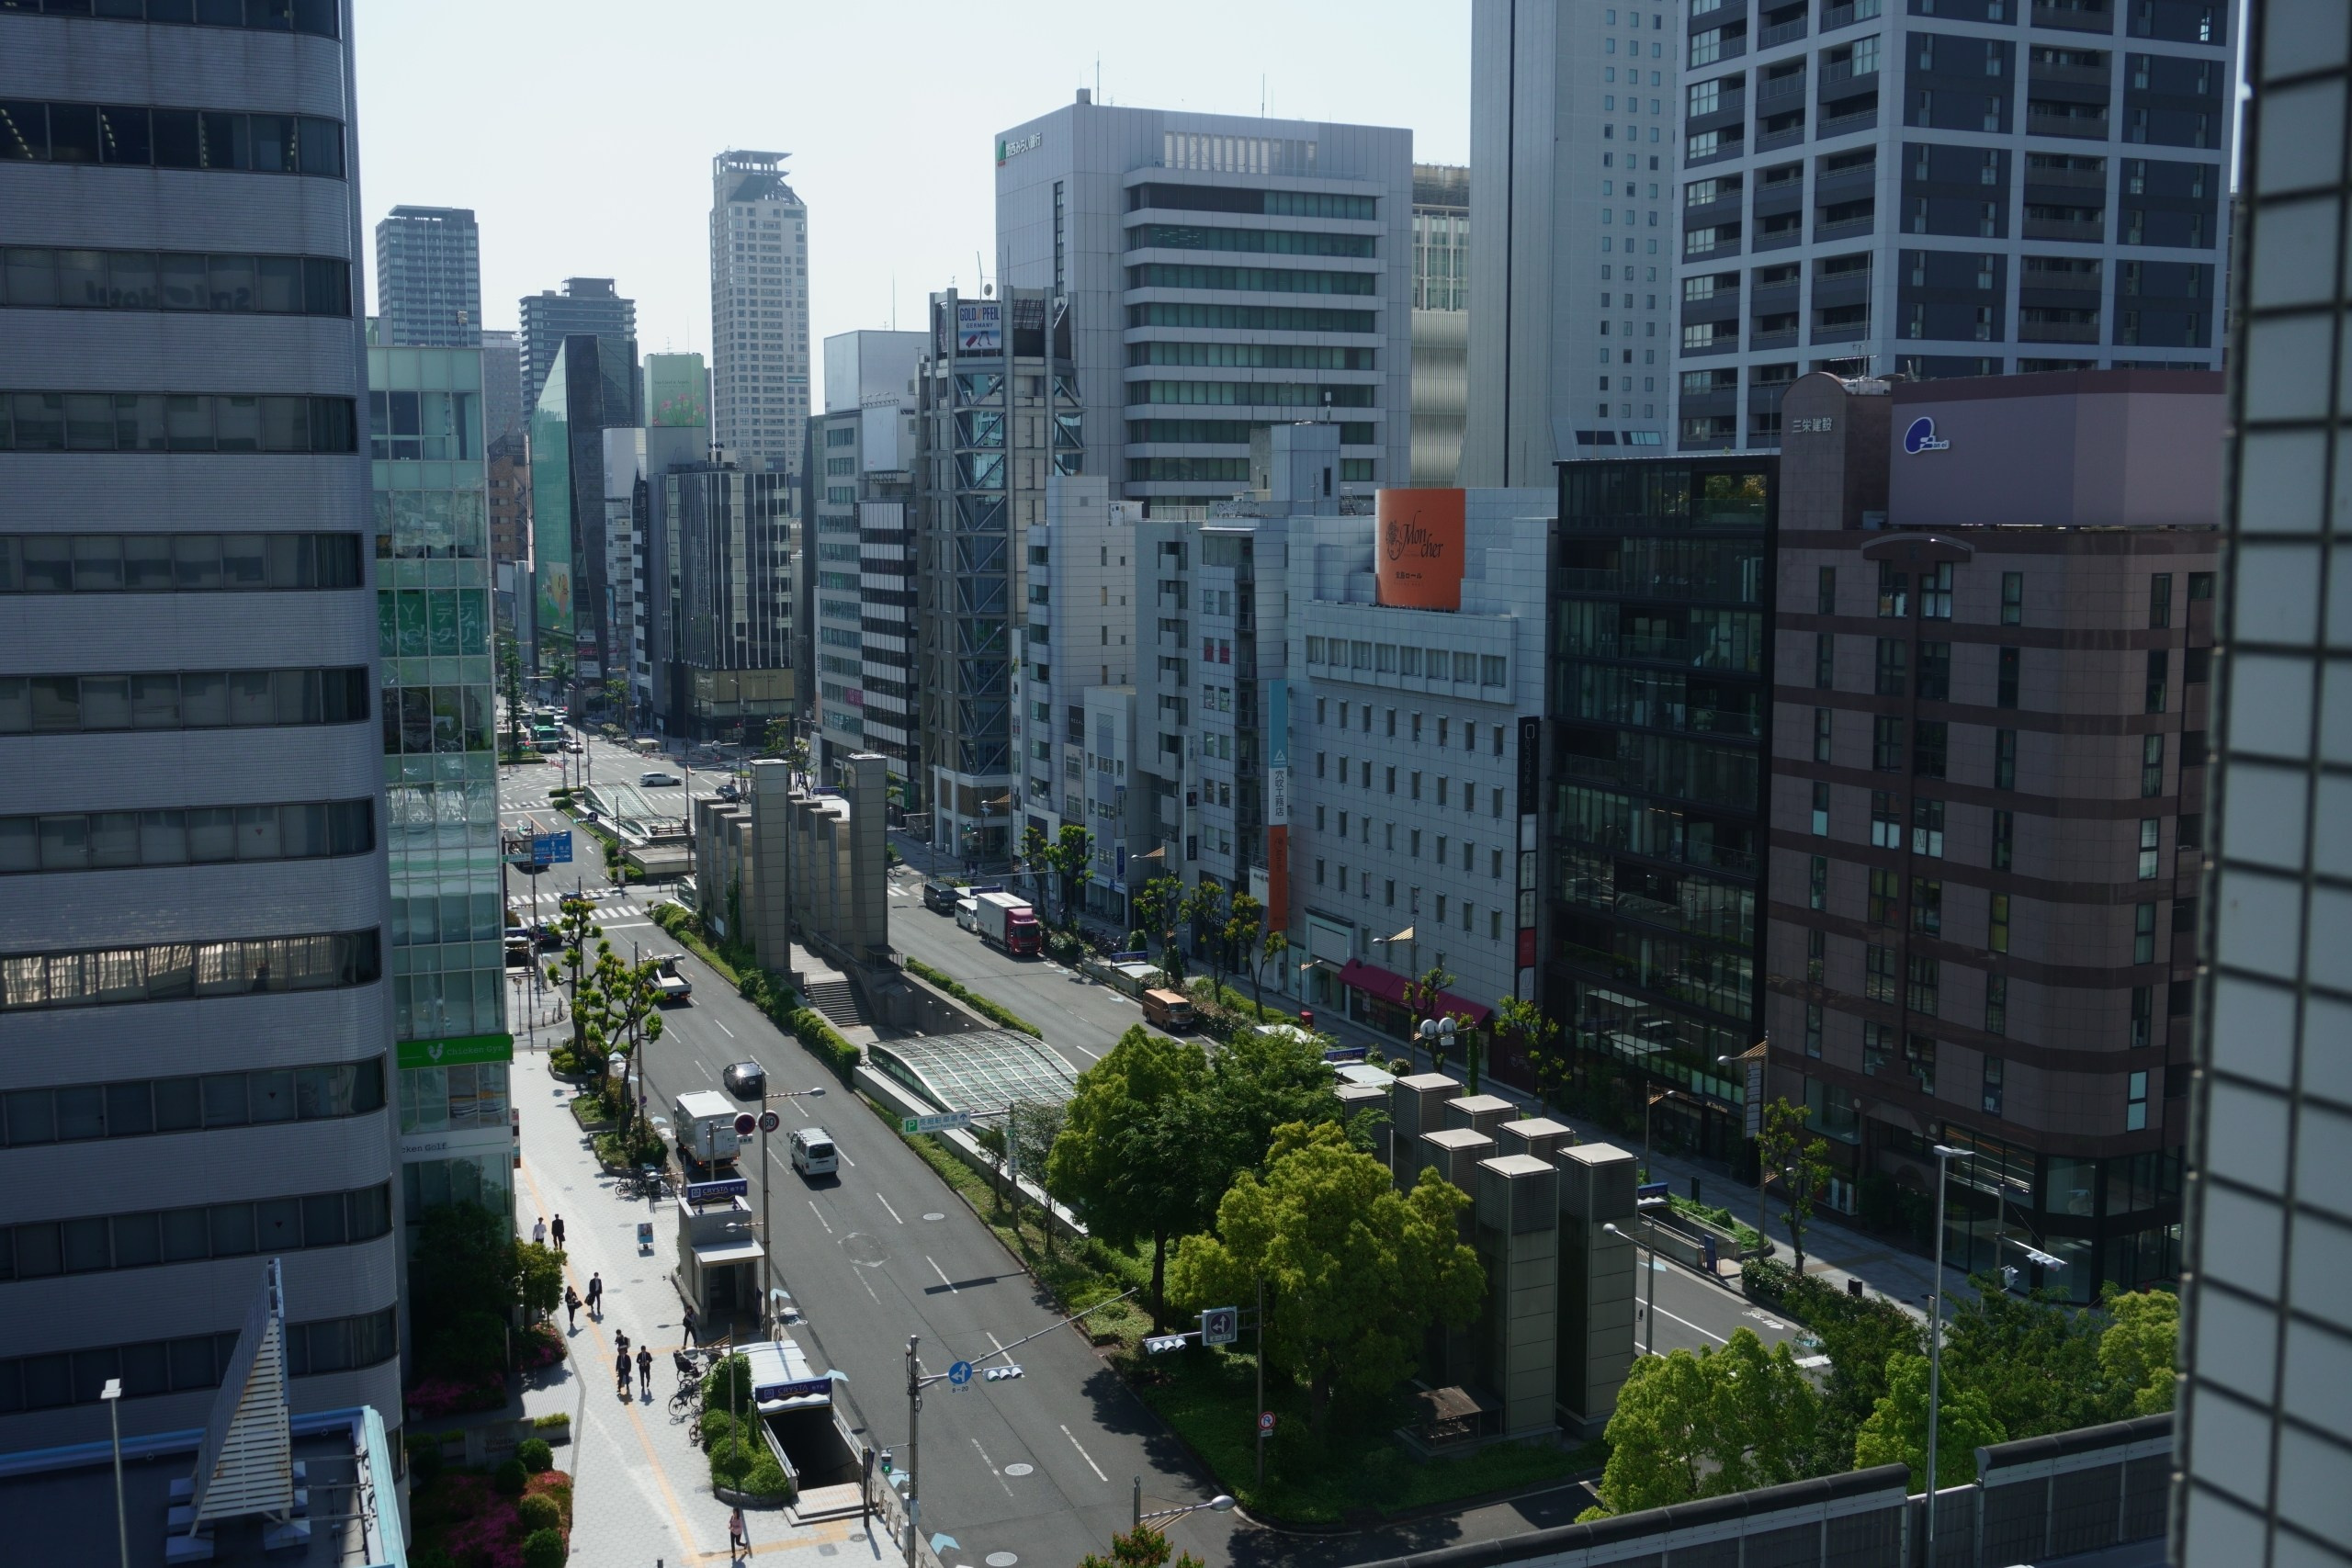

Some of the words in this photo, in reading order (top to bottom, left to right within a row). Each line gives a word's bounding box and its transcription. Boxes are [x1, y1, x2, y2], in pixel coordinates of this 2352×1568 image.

[959, 307, 977, 321] GOLD
[982, 306, 1000, 321] PFEIL
[1792, 417, 1833, 434] 三栄建設
[1400, 510, 1427, 549] Mon
[1421, 533, 1444, 558] cher
[1274, 770, 1284, 817] 穴吹工務店
[447, 1045, 485, 1055] Chicken
[486, 1044, 504, 1053] Gym
[764, 1117, 775, 1128] 50
[919, 1114, 958, 1126] 長堀駐車場
[424, 1142, 447, 1152] Golf
[702, 1185, 729, 1195] CRYSTA
[777, 1383, 808, 1394] CRYSTA
